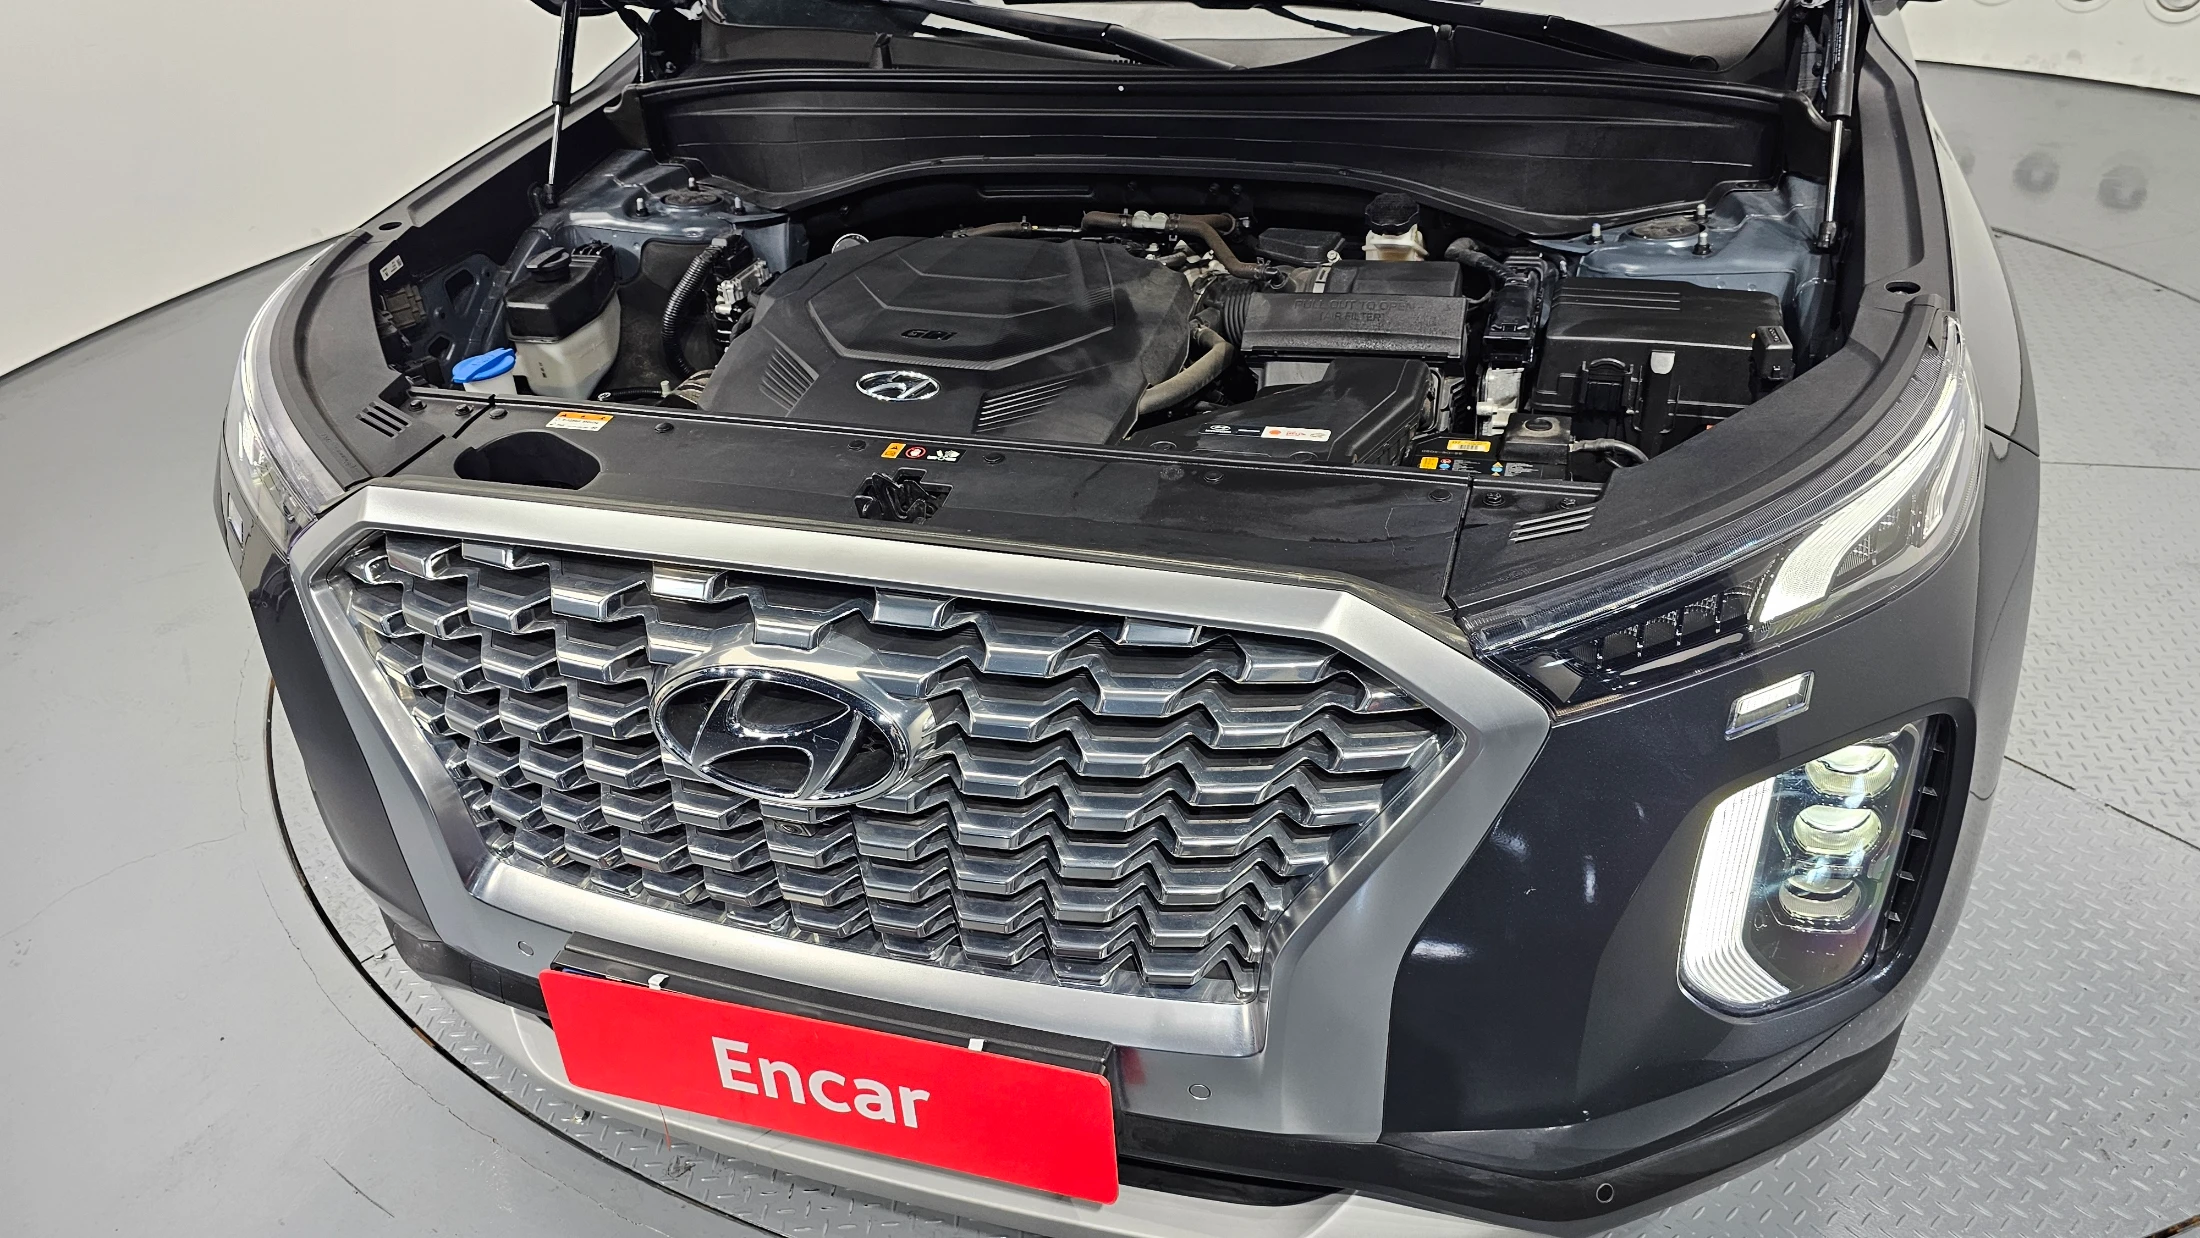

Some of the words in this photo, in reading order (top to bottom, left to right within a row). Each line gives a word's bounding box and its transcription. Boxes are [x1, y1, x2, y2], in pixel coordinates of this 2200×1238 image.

[1294, 299, 1326, 310] PULL
[1329, 299, 1356, 310] OUT
[1359, 300, 1377, 311] TO
[1378, 300, 1415, 312] OPEN
[711, 1036, 931, 1129] Encar
